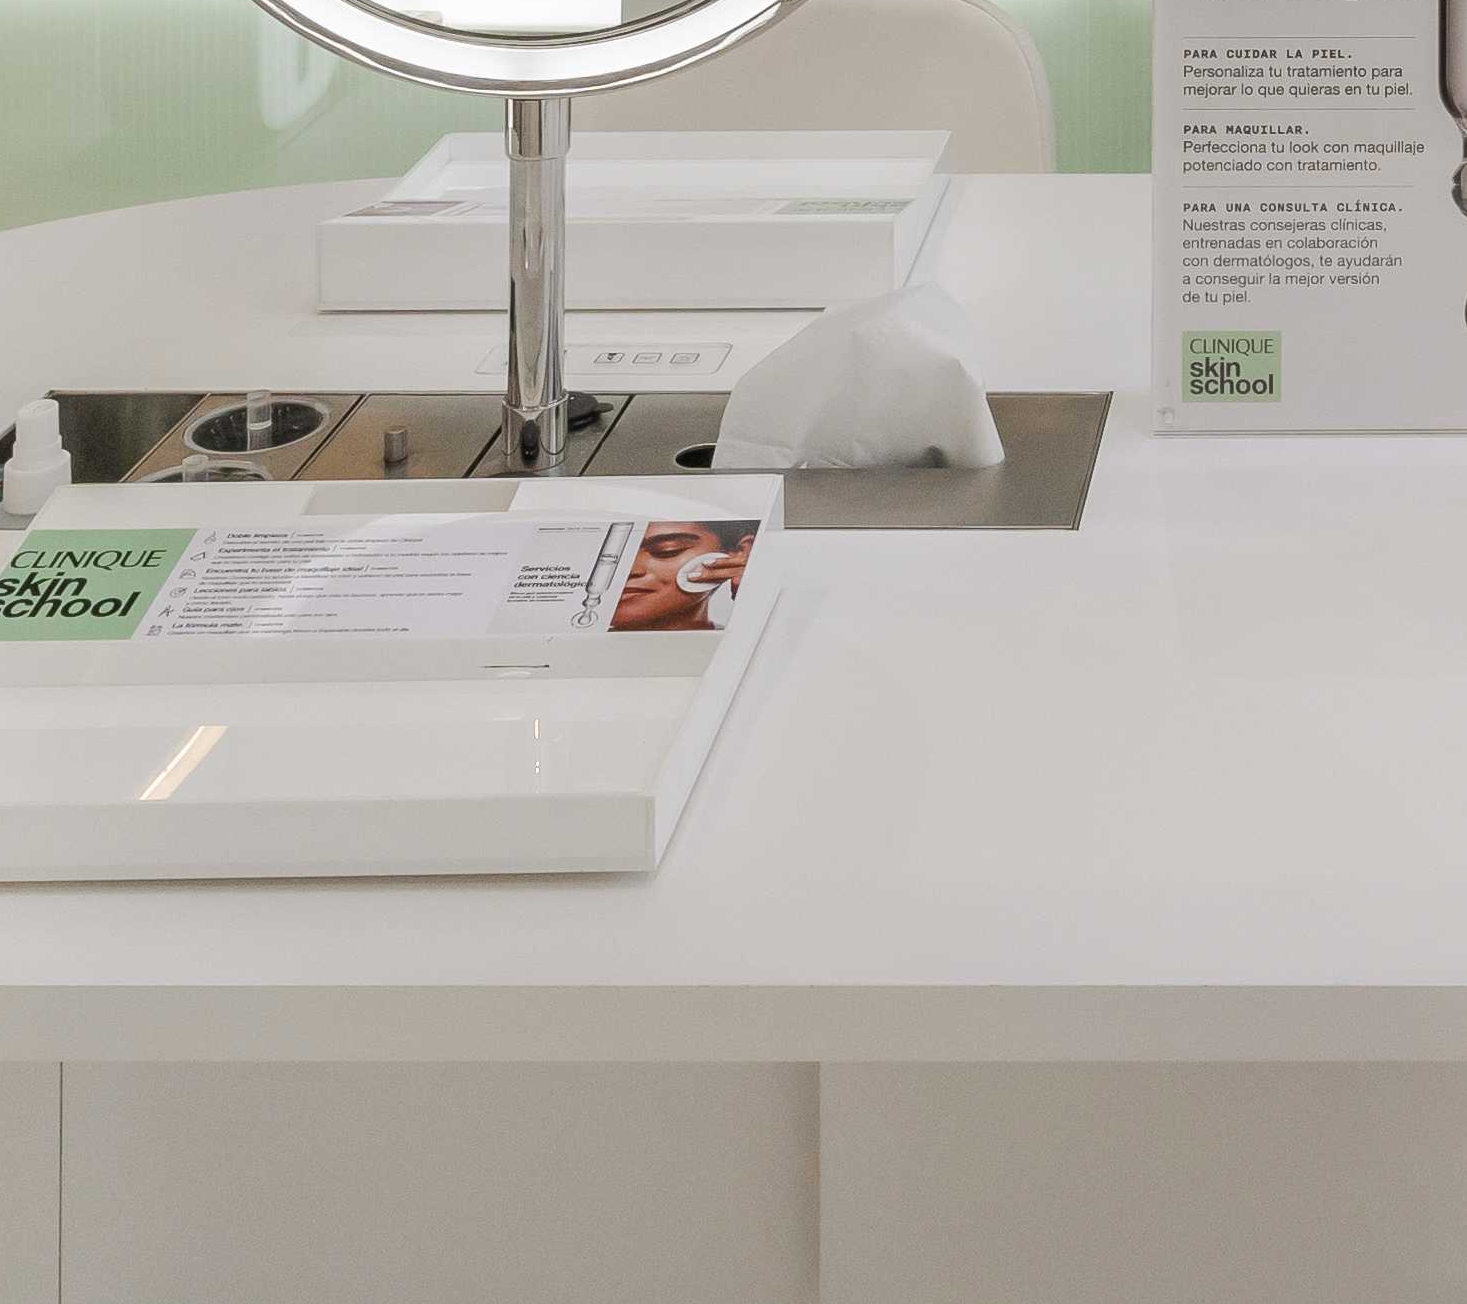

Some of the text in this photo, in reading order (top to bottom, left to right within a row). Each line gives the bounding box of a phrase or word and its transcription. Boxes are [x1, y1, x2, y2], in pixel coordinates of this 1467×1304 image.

[1184, 49, 1352, 59] PARA CUIDAR LA PIEL.
[1183, 65, 1402, 80] Personaliza tu tratamiento para
[1183, 84, 1413, 98] mejorar lo que quieras en tu piel.
[1183, 125, 1309, 136] PARA MAQUILLAR.
[1183, 141, 1425, 156] Perfecciona tu look con maquillaje
[1183, 160, 1381, 173] potenciado con tratamiento.
[1183, 200, 1403, 212] PARA UNA CONSULTA CLÍNICA.
[1183, 219, 1387, 233] Nuestras consejeras clínicas,
[1182, 237, 1378, 249] entrenadas en colaboración
[1189, 338, 1274, 356] CLINIQUE
[1190, 358, 1241, 378] skin
[1190, 374, 1274, 395] school
[10, 547, 169, 572] CLINIQUE
